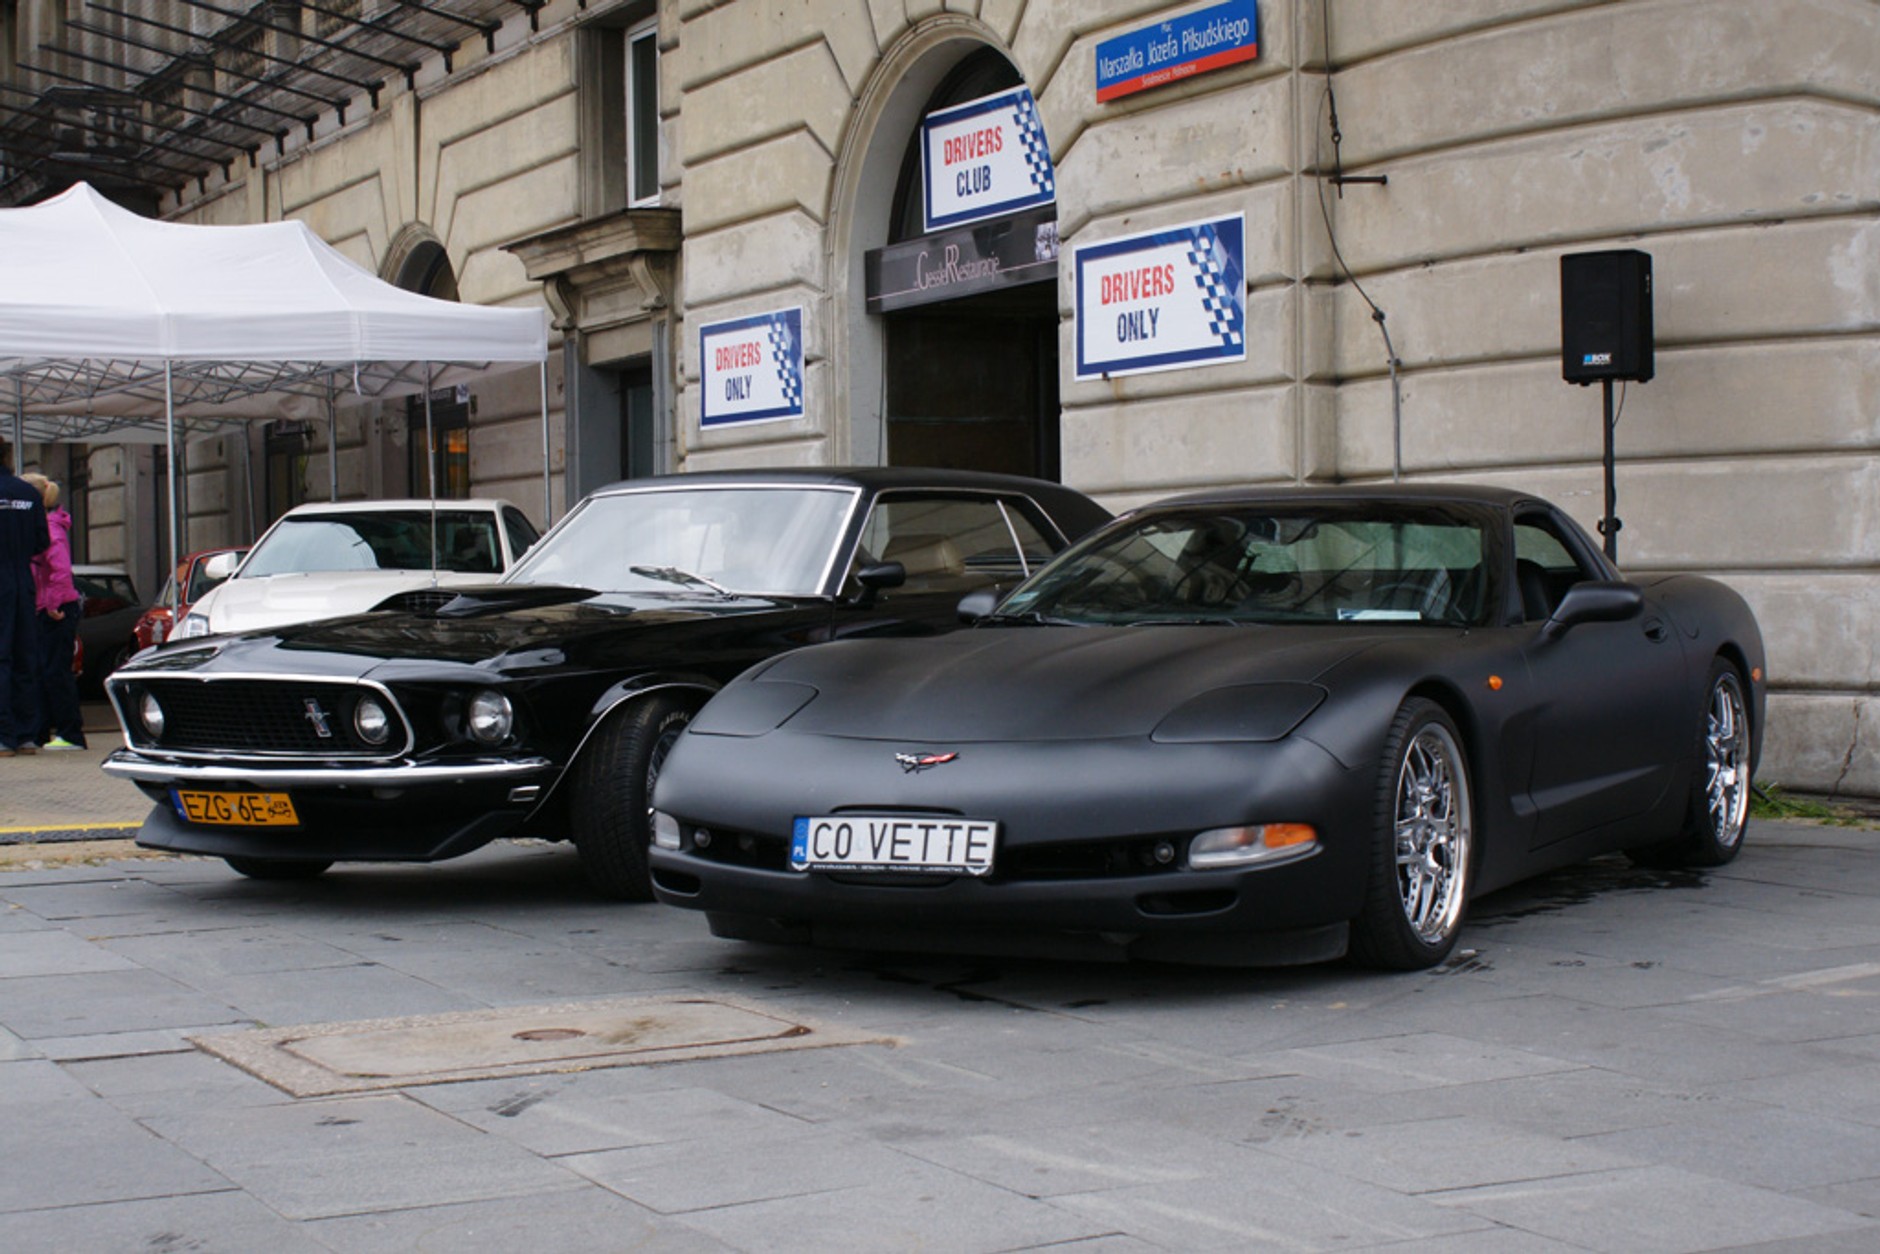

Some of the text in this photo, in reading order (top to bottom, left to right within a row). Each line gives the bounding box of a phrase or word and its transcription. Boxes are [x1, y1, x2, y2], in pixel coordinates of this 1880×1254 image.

[1099, 18, 1249, 80] Marszałka Józefa Piłsudskiego
[944, 125, 1003, 166] DRIVERS
[956, 165, 991, 197] CLUB
[1101, 264, 1175, 305] DRIVERS
[1117, 307, 1160, 343] ONLY
[716, 341, 761, 372] DRIVERS
[725, 375, 752, 402] ONLY
[182, 793, 267, 822] EZG 6E
[793, 846, 805, 857] PL
[869, 822, 990, 864] VETTE
